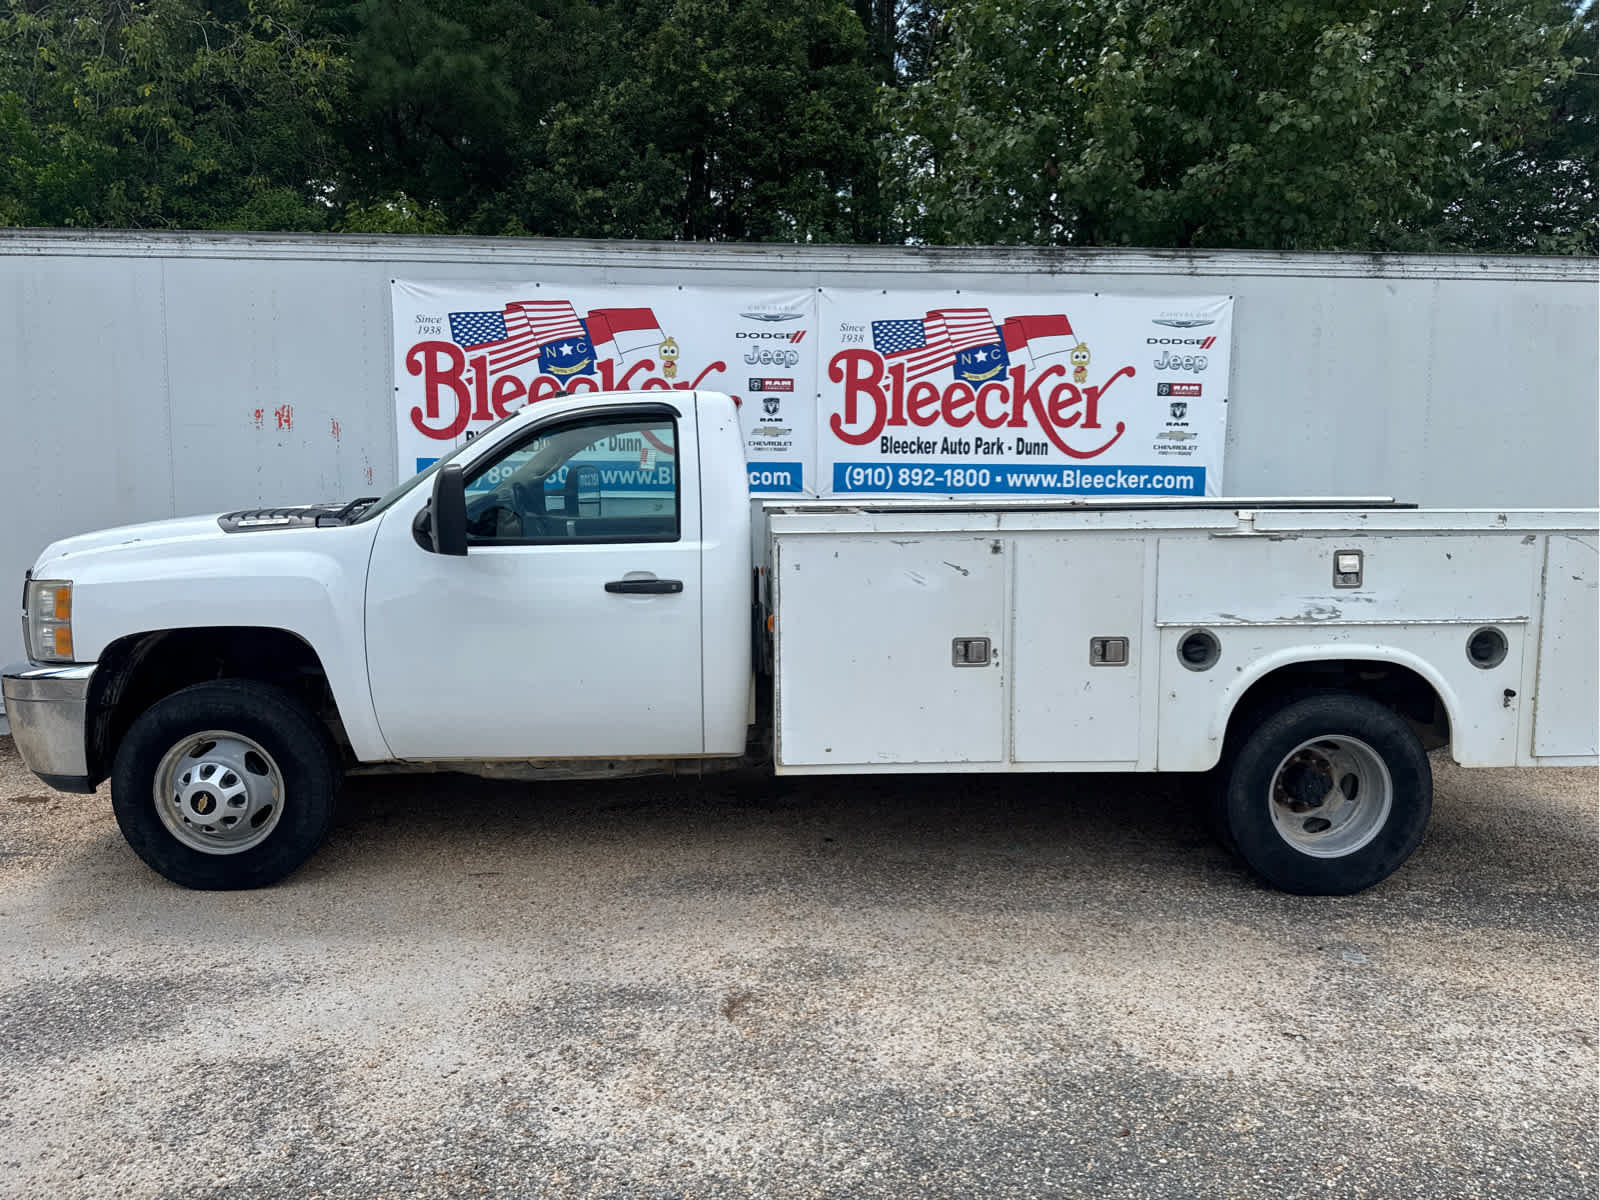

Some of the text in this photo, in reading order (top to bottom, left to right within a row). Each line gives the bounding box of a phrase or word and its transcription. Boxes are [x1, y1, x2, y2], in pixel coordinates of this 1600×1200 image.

[416, 314, 442, 324] Since
[417, 326, 442, 335] 1938
[840, 323, 865, 333] Since
[735, 331, 800, 340] DODGE
[841, 334, 865, 343] 1938
[1146, 337, 1208, 346] DODGE
[744, 345, 799, 368] Jeep
[1153, 351, 1208, 374] Jeep
[828, 349, 1136, 459] Bleecker
[609, 434, 642, 452] Dunn
[880, 436, 1048, 456] Bleecker Auto Park Dunn
[845, 465, 1194, 490] (910) 892-1800 www.Bleecker.com
